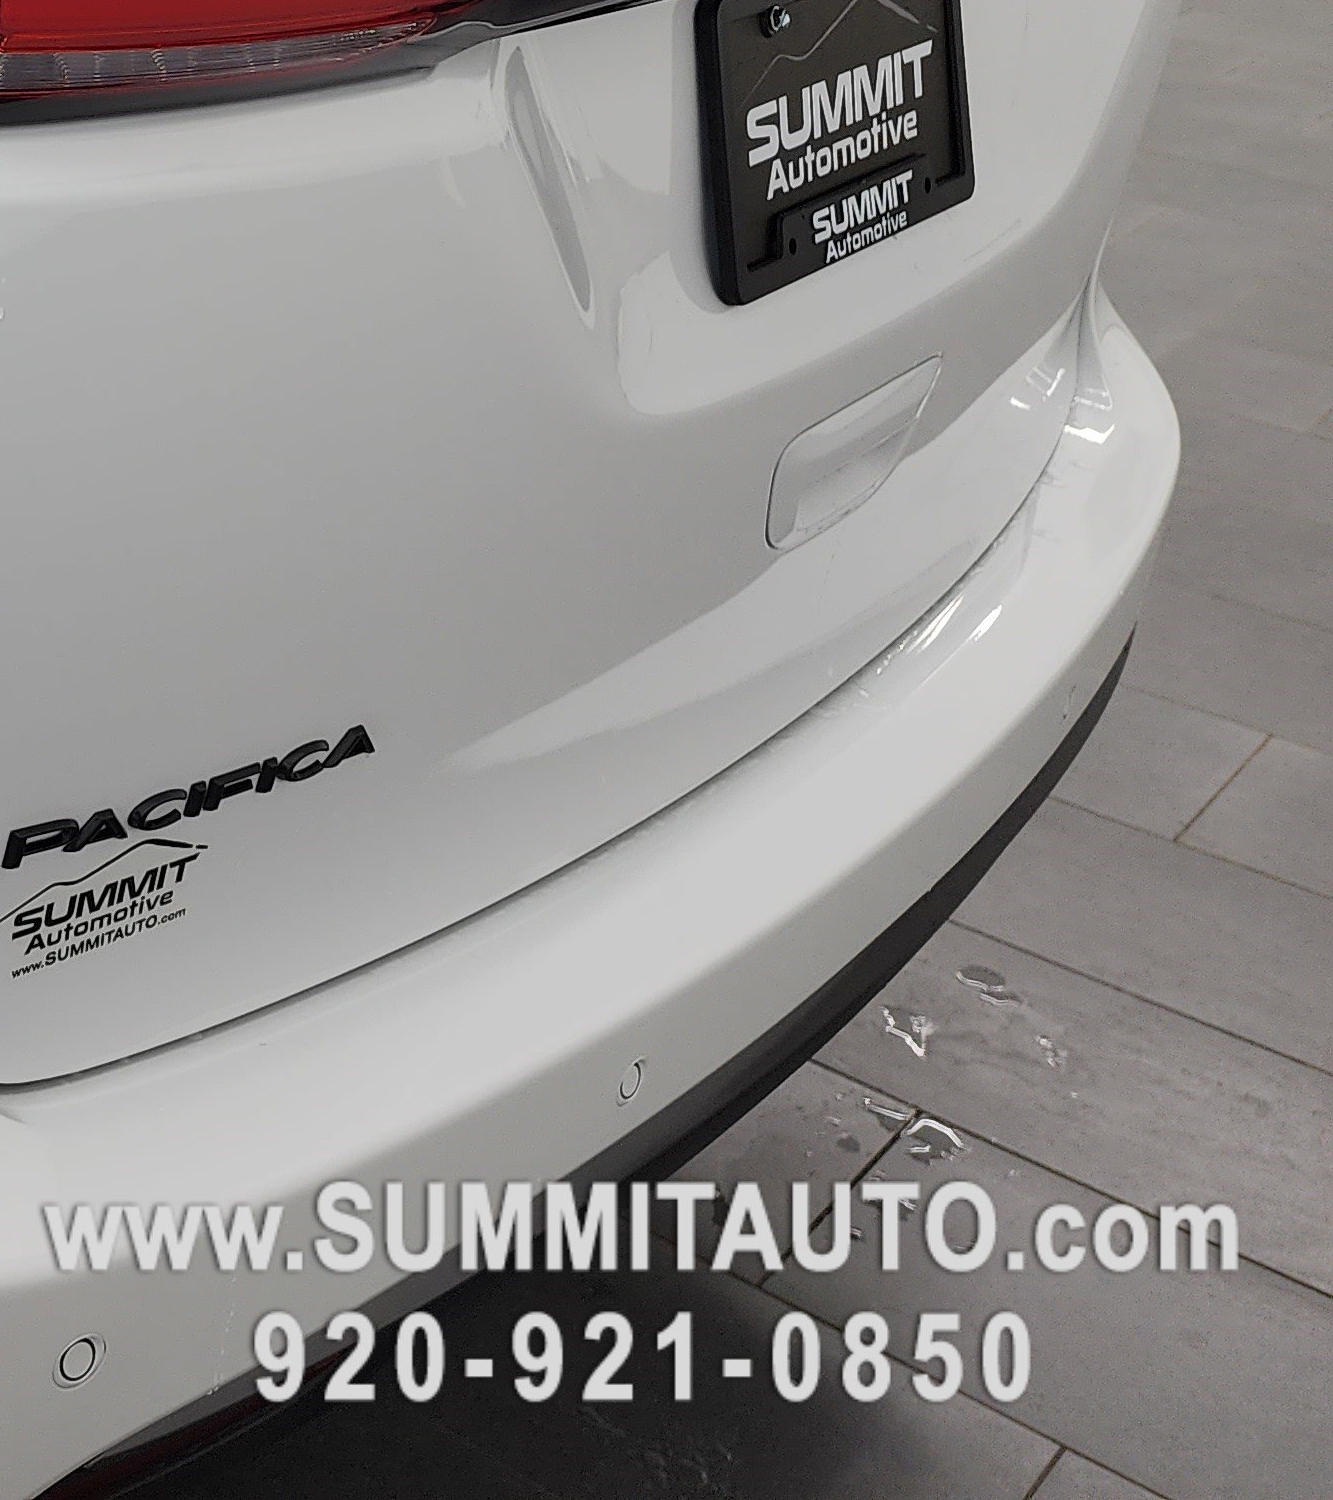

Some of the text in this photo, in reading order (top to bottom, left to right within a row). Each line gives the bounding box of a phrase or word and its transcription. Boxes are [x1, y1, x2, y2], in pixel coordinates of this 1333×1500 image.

[746, 38, 933, 168] SUMMIT
[766, 107, 918, 201] Automotive
[812, 169, 913, 245] SUMMIT
[825, 209, 907, 264] Automotive
[0, 723, 376, 870] PACIFICA
[11, 851, 201, 941] SUMMIT
[23, 889, 174, 956] Automotive
[11, 908, 187, 979] www.SUMMITAUTO.com
